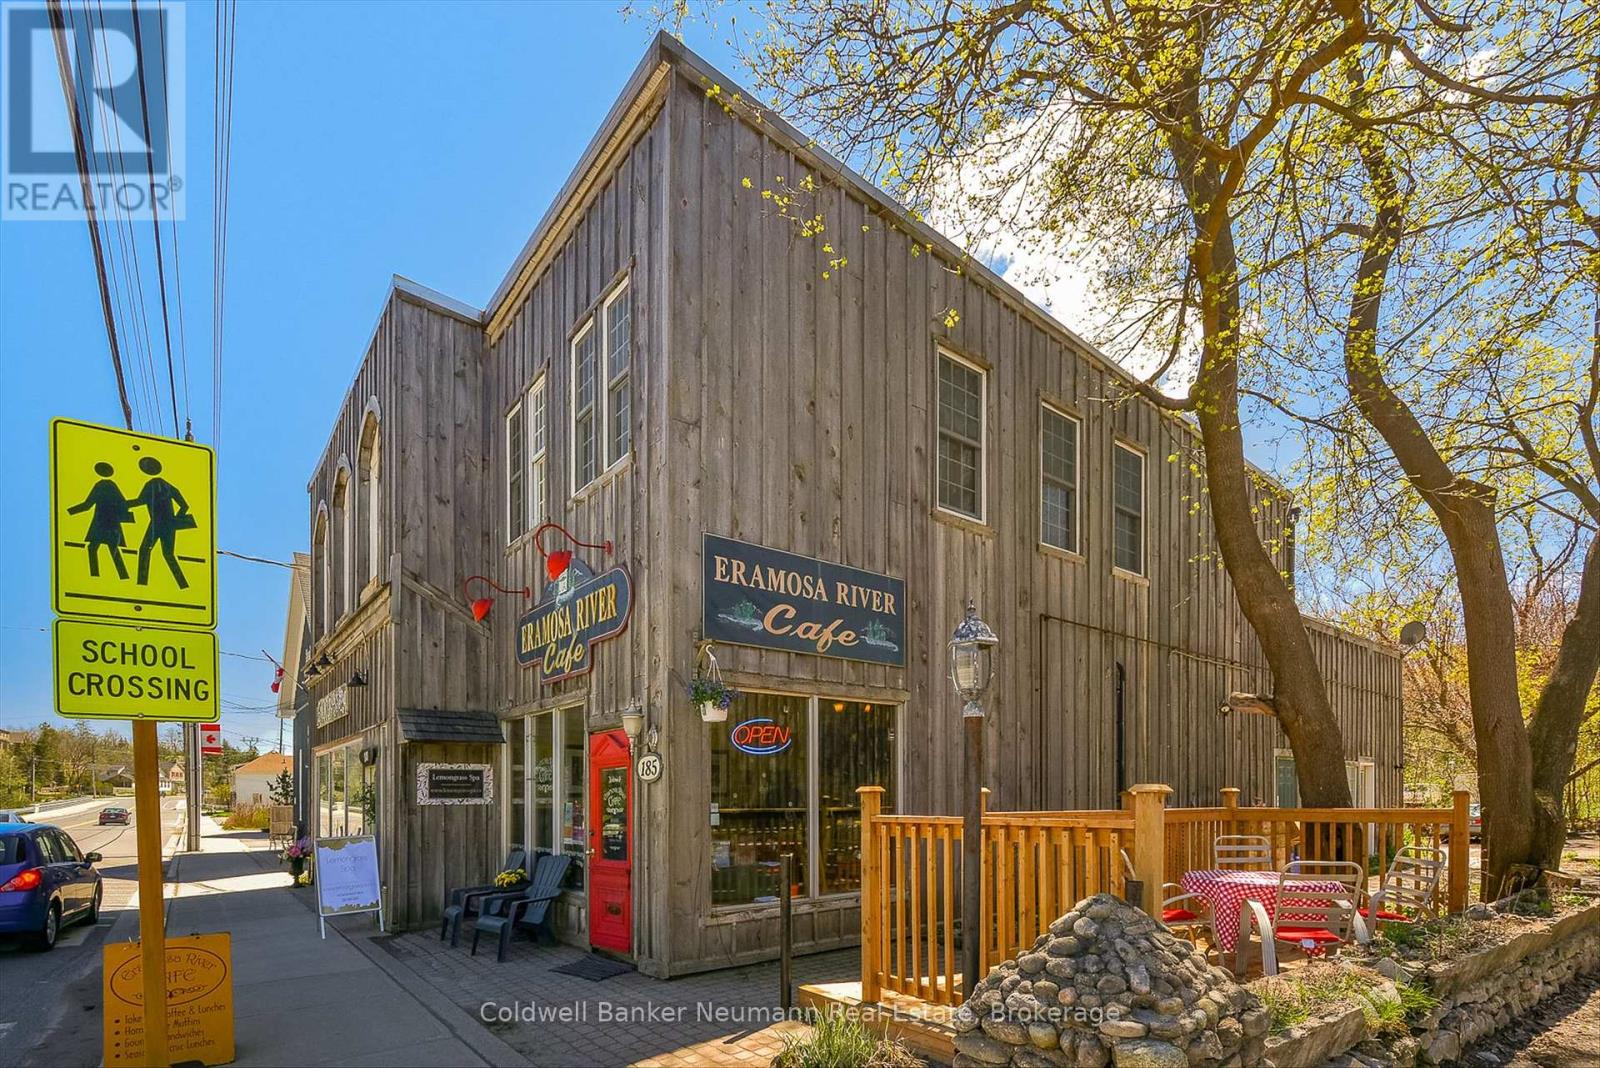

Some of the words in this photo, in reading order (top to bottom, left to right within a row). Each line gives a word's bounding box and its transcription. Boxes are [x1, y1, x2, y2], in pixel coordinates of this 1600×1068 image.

[713, 555, 828, 602] ERAMOSA
[836, 581, 897, 615] RIVER
[521, 605, 572, 654] ERAMOSA
[576, 583, 618, 632] RIVER
[763, 603, 861, 654] Cafe
[81, 640, 196, 670] SCHOOL
[543, 635, 585, 675] Cafe
[68, 672, 209, 702] CROSSING
[734, 726, 790, 745] OPEN
[432, 773, 468, 782] Lemongrass
[469, 773, 480, 782] Spa
[641, 759, 658, 777] 185
